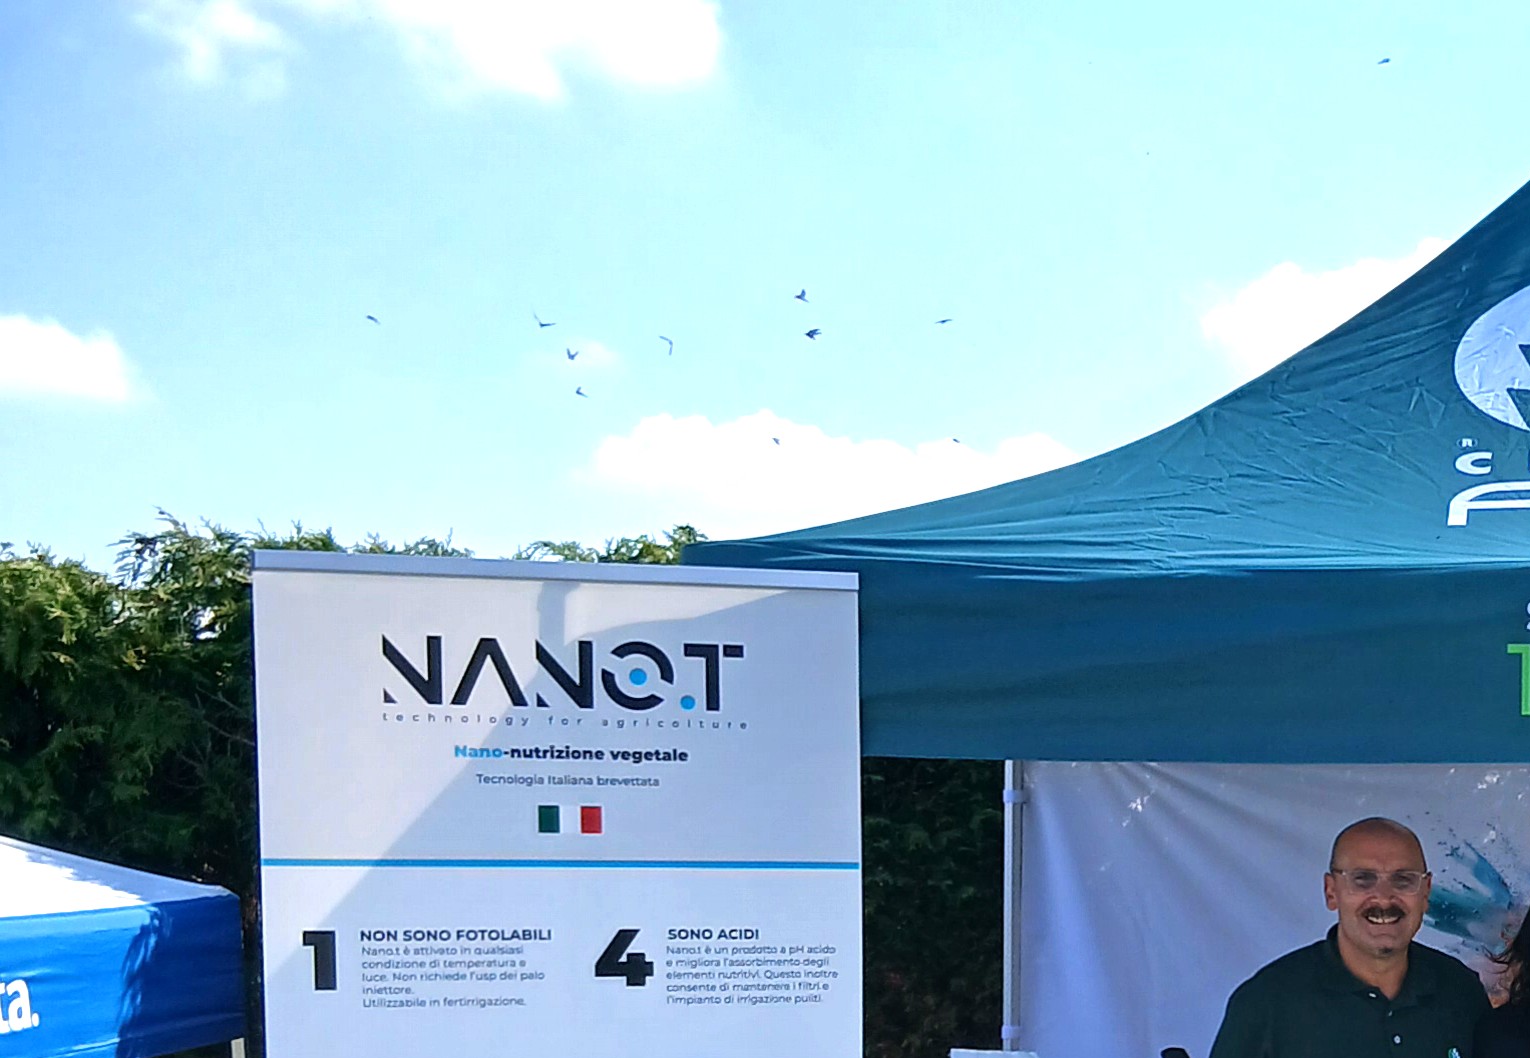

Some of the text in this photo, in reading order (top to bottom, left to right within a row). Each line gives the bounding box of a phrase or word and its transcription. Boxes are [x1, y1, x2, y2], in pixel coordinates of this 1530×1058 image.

[382, 711, 530, 727] technology
[547, 715, 583, 727] for
[453, 745, 689, 766] Nano-nutrizione vegetale
[475, 773, 660, 789] Tecnologia Italiana brevettata
[359, 929, 553, 942] NON SONO FOTOLABILI
[667, 928, 760, 940] SONO ACIDI
[303, 930, 337, 991] 1
[595, 928, 654, 987] 4
